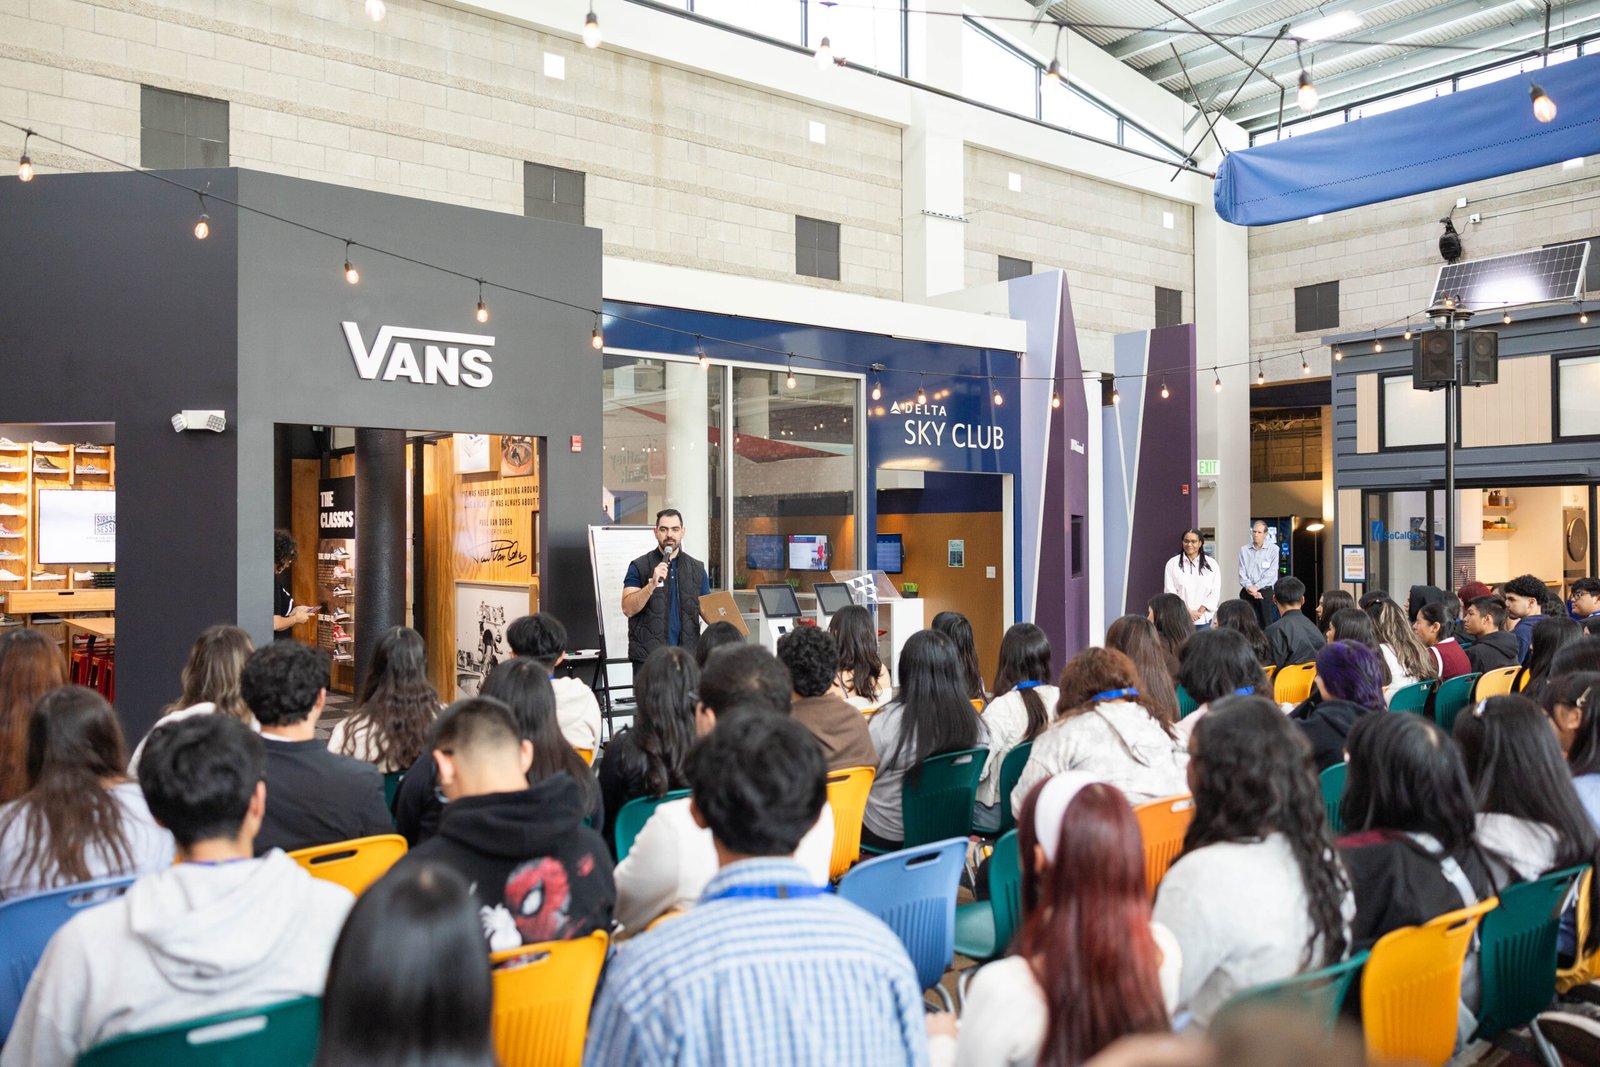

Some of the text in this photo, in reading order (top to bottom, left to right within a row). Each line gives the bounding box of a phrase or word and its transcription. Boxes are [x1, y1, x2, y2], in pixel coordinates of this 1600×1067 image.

[341, 321, 496, 388] VANS
[905, 403, 947, 417] DELTA
[904, 420, 1005, 450] SKY CLUB
[1199, 460, 1217, 474] EXIT
[477, 488, 490, 497] NEVER
[490, 487, 503, 496] ABOUT
[504, 486, 520, 495] WAVING
[521, 485, 539, 494] AROUND
[320, 491, 334, 507] THE
[495, 499, 504, 507] WAS
[504, 498, 520, 507] ALWAYS
[521, 497, 536, 506] ABOUT
[320, 511, 354, 528] CLASSICS
[490, 518, 498, 526] VAN
[499, 518, 513, 526] DOREN
